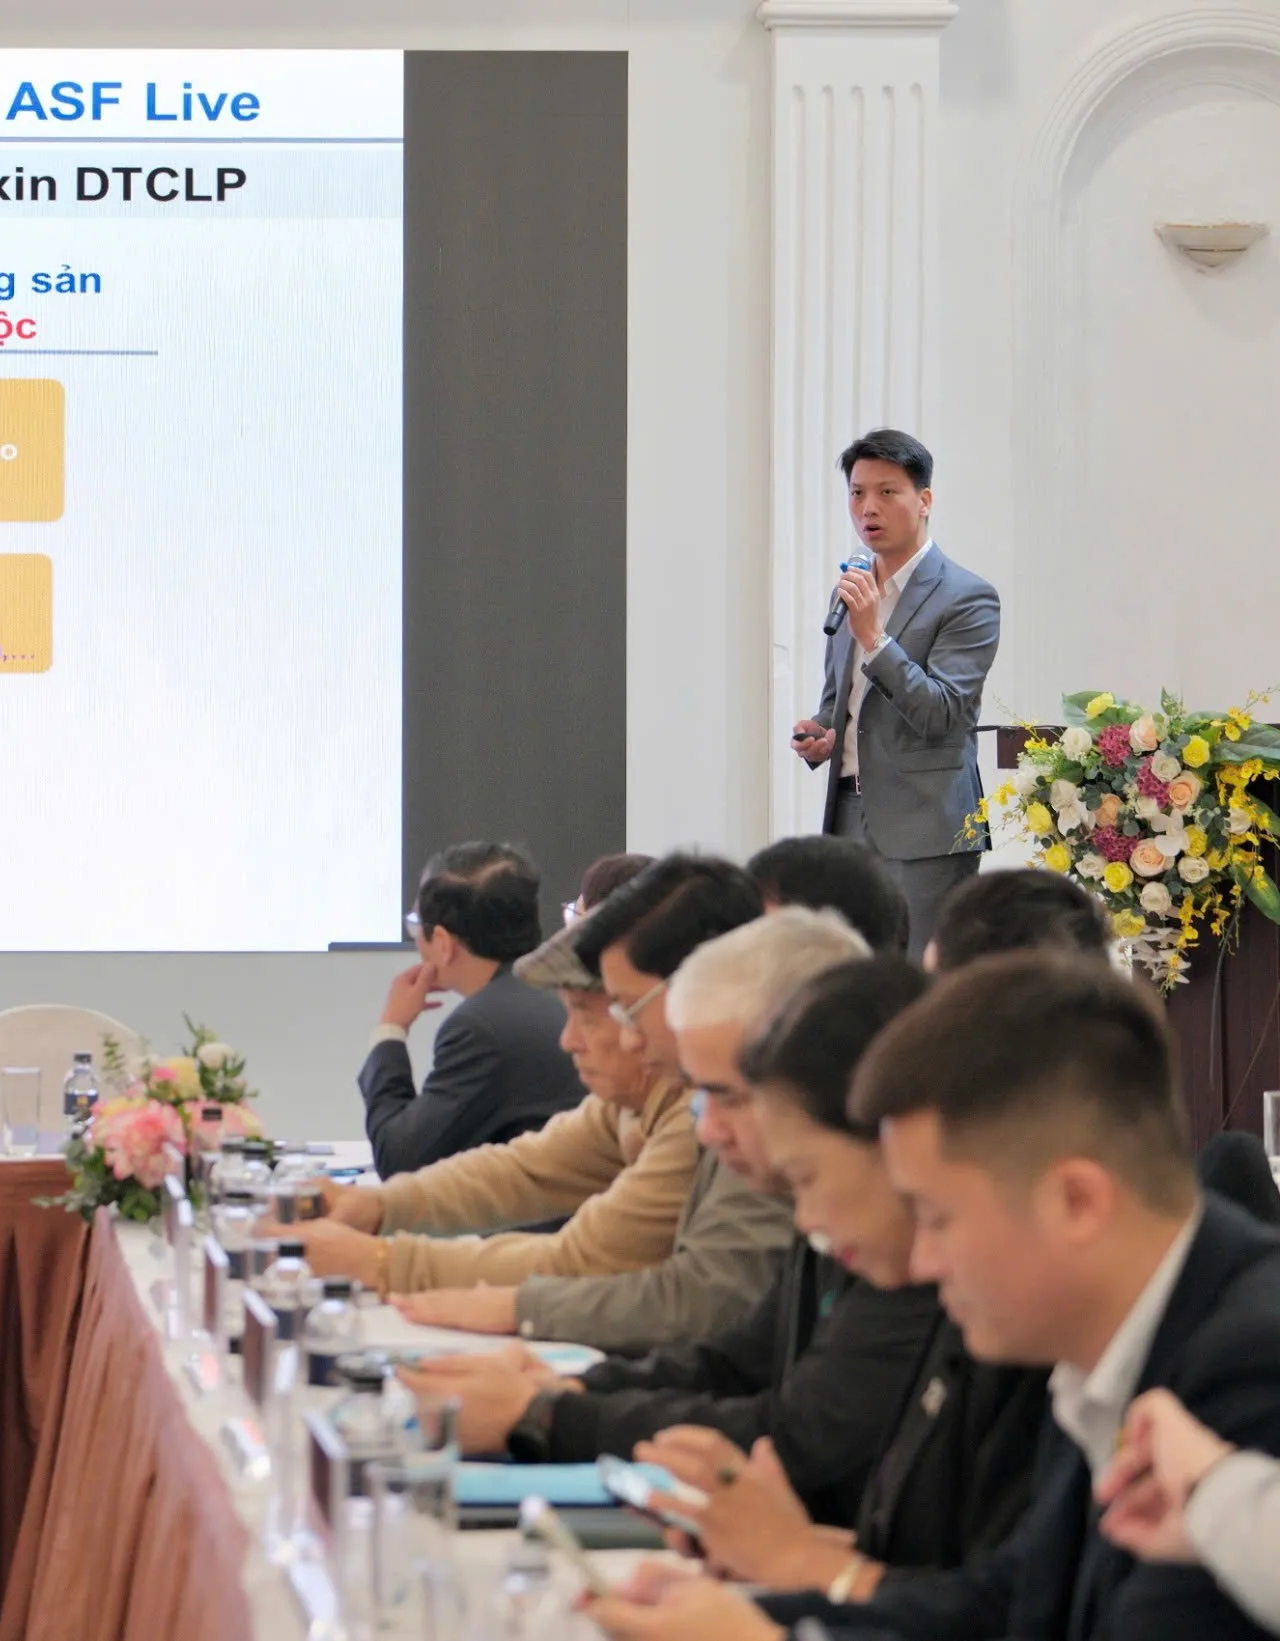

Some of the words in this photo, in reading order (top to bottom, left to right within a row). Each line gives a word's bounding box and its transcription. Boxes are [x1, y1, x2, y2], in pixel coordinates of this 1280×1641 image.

[4, 80, 123, 122] ASF
[144, 80, 262, 123] Live
[75, 165, 248, 203] DTCLP
[31, 263, 103, 296] sản
